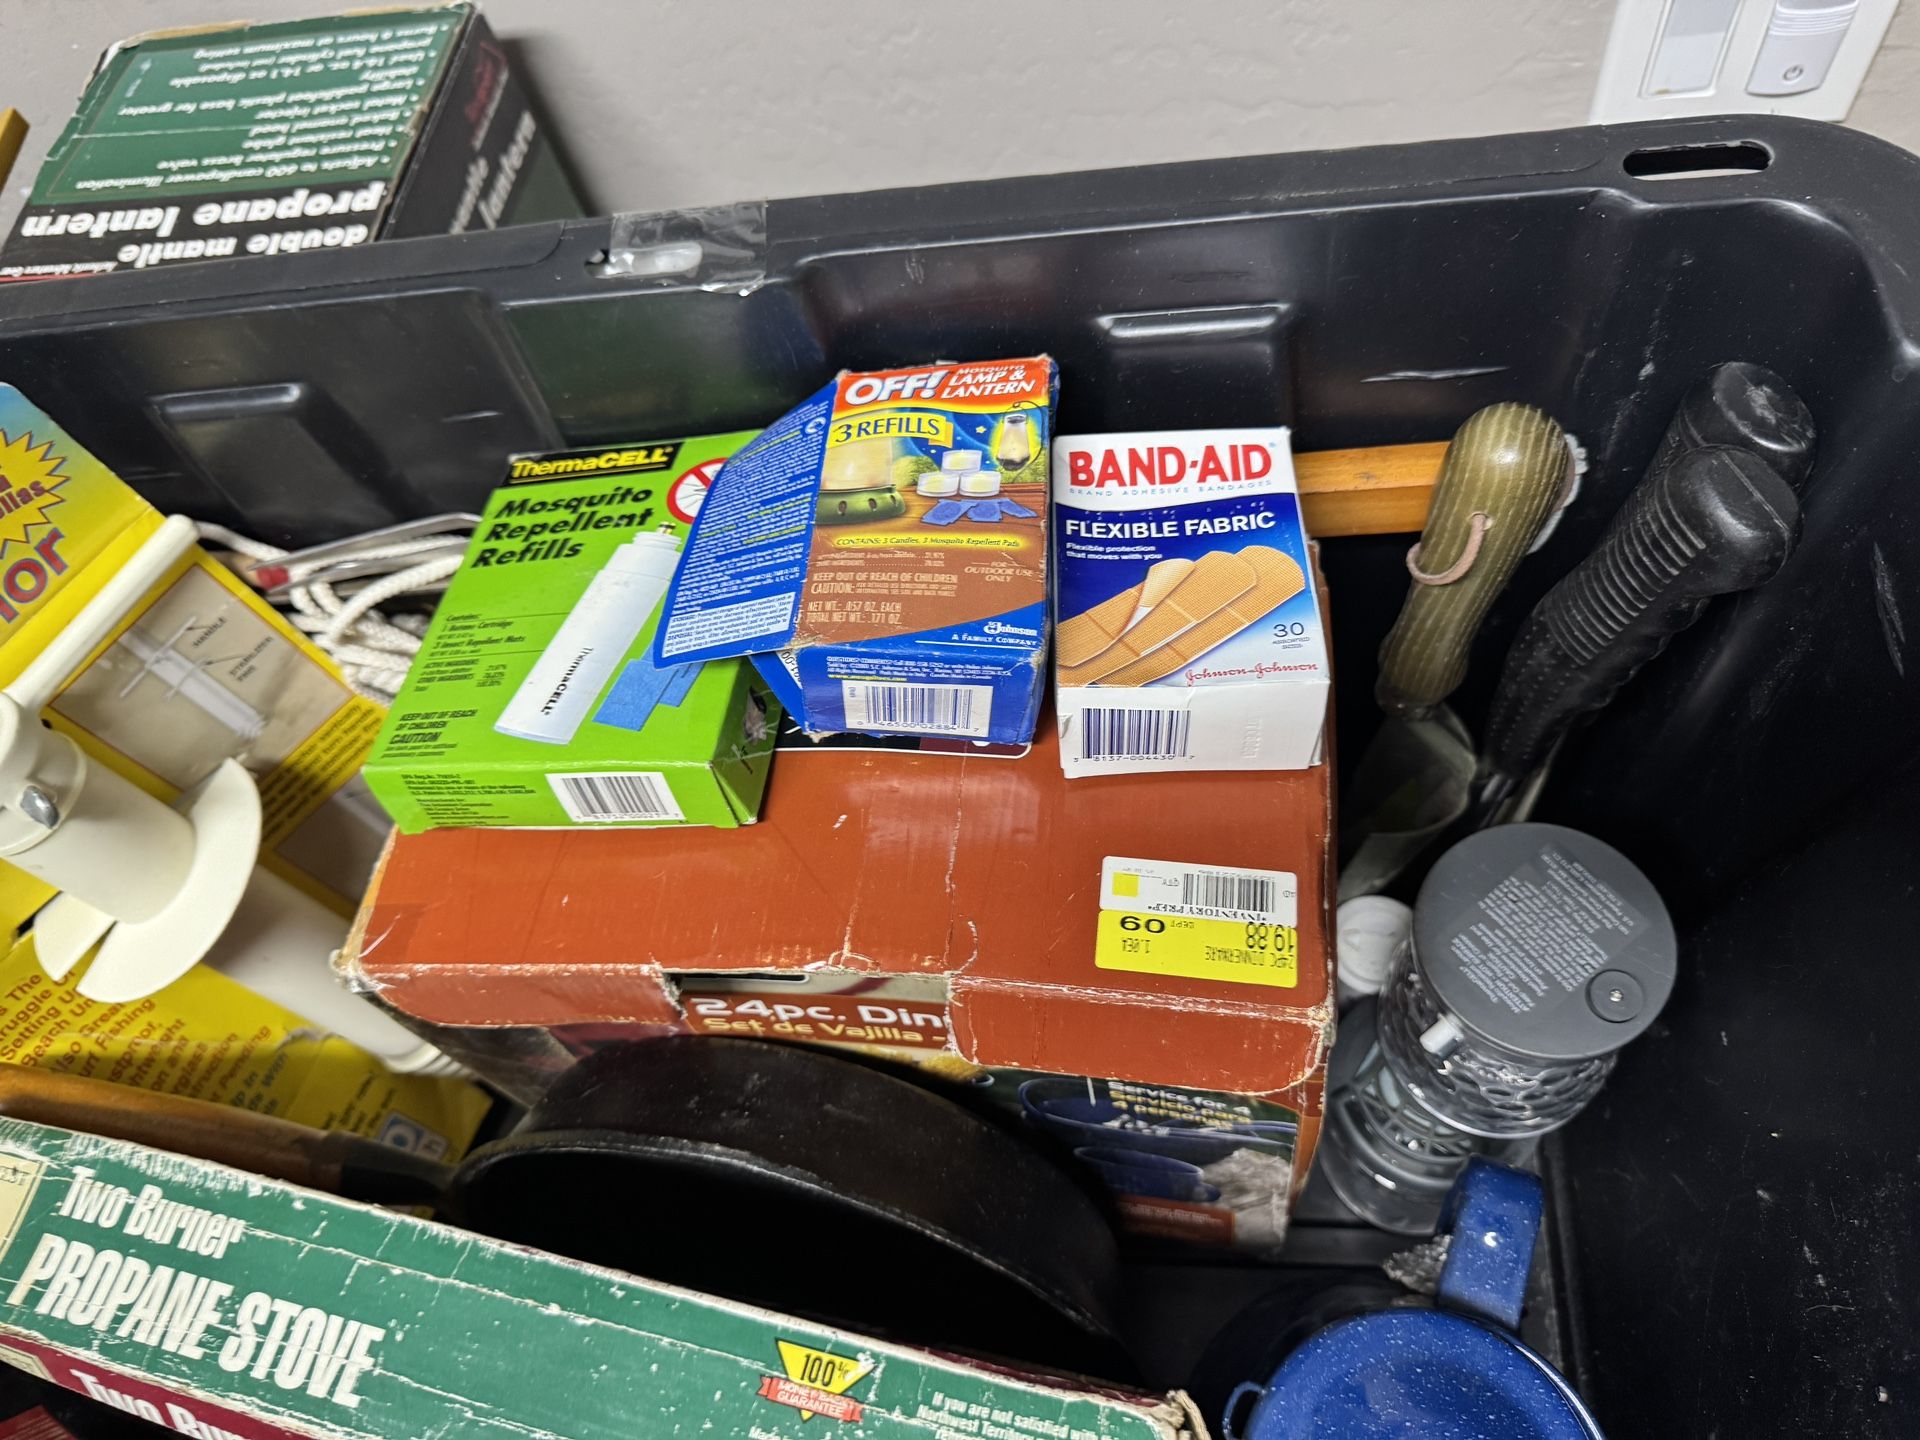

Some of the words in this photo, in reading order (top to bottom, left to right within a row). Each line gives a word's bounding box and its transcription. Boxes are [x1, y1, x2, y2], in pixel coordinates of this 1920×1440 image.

[242, 37, 315, 53] maximum
[336, 30, 378, 43] hours
[193, 48, 240, 59] setting
[276, 49, 334, 63] cylinder
[334, 46, 366, 58] fuel
[168, 71, 245, 88] disposable
[117, 101, 173, 115] greater
[173, 102, 196, 113] for
[198, 98, 235, 110] base
[237, 92, 286, 107] plastic
[254, 105, 310, 120] injector
[287, 129, 353, 145] resistant
[353, 123, 392, 137] Heat
[241, 134, 286, 149] globe
[318, 138, 385, 155] Pressure
[200, 153, 243, 167] brass
[245, 145, 316, 162] regulator
[320, 153, 378, 170] Adjusts
[155, 158, 197, 170] valve
[264, 162, 297, 177] 600
[299, 161, 317, 171] to
[75, 175, 163, 190] illumination
[163, 166, 263, 183] candlepower
[193, 180, 386, 228] propane
[20, 204, 180, 240] lantern
[247, 223, 369, 257] double
[117, 235, 237, 268] mantle
[949, 371, 1007, 386] LAMP
[1010, 370, 1027, 381] &
[845, 370, 950, 406] OFF!
[941, 379, 1035, 399] LANTERN
[834, 424, 852, 443] 3
[856, 417, 940, 437] REFILLS
[1068, 443, 1272, 488] BAND-AID
[1069, 487, 1113, 496] BRAND
[1122, 487, 1190, 496] ADHESIVE
[1199, 480, 1272, 492] BANDAGES
[495, 486, 654, 519] Mosquito
[483, 508, 654, 543] Repellent
[1065, 518, 1180, 539] FLEXIBLE
[1184, 511, 1276, 536] FABRIC
[836, 537, 881, 546] CONTAINS:
[882, 537, 888, 545] 3
[966, 538, 1001, 547] Repellent
[1066, 542, 1104, 552] Flexible
[1105, 545, 1156, 553] protection
[471, 537, 585, 569] Refills
[1066, 551, 1086, 559] that
[1087, 552, 1120, 560] moves
[1121, 552, 1141, 560] with
[1143, 553, 1163, 561] you
[813, 573, 835, 582] KEEP
[836, 573, 854, 582] OUT
[856, 573, 868, 582] OF
[870, 573, 898, 582] REACH
[900, 573, 913, 582] OF
[915, 573, 958, 584] CHILDREN
[964, 566, 1014, 576] OUTDOOR
[985, 575, 1012, 583] ONLY
[811, 583, 855, 595] CAUTION:
[807, 601, 823, 612] NET
[880, 602, 902, 612] EACH
[807, 612, 829, 622] TOTAL
[830, 613, 847, 623] NET
[1272, 622, 1305, 637] 30
[951, 633, 959, 641] A
[962, 633, 994, 643] FAMILY
[995, 636, 1038, 646] COMPANY
[449, 709, 478, 718] REACH
[408, 721, 449, 730] CHILDREN
[389, 732, 442, 744] CAUTION
[1120, 915, 1166, 934] 09
[1204, 945, 1265, 967] DINNERWARE
[1450, 935, 1482, 965] SURFACE
[1498, 953, 1531, 983] Directions
[4, 969, 44, 1006] The
[1492, 977, 1531, 1013] ATTENTION
[1516, 989, 1536, 1008] Keep
[690, 998, 846, 1021] 24pc.
[857, 1005, 949, 1027] Din
[92, 992, 157, 1053] Fishing
[703, 1017, 765, 1033] Set
[773, 1020, 814, 1034] de
[818, 1023, 923, 1041] Vajilla
[0, 1001, 64, 1063] Setting
[14, 1014, 77, 1071] Beach
[1108, 1081, 1188, 1102] Service
[1193, 1097, 1227, 1110] for
[1233, 1107, 1251, 1115] 4
[1109, 1091, 1196, 1112] Servicio
[1201, 1108, 1251, 1124] para
[1112, 1101, 1128, 1110] 4
[1134, 1105, 1233, 1130] personas
[58, 1165, 129, 1229] Two
[123, 1183, 246, 1259] Burner
[8, 1233, 234, 1360] PROPANE
[218, 1291, 385, 1409] STOVE
[777, 1390, 844, 1415] GUARANTEE
[917, 1404, 980, 1433] Northwest
[943, 1397, 968, 1414] you
[968, 1402, 990, 1418] are
[991, 1409, 1013, 1424] not
[1013, 1414, 1070, 1438] satisfied
